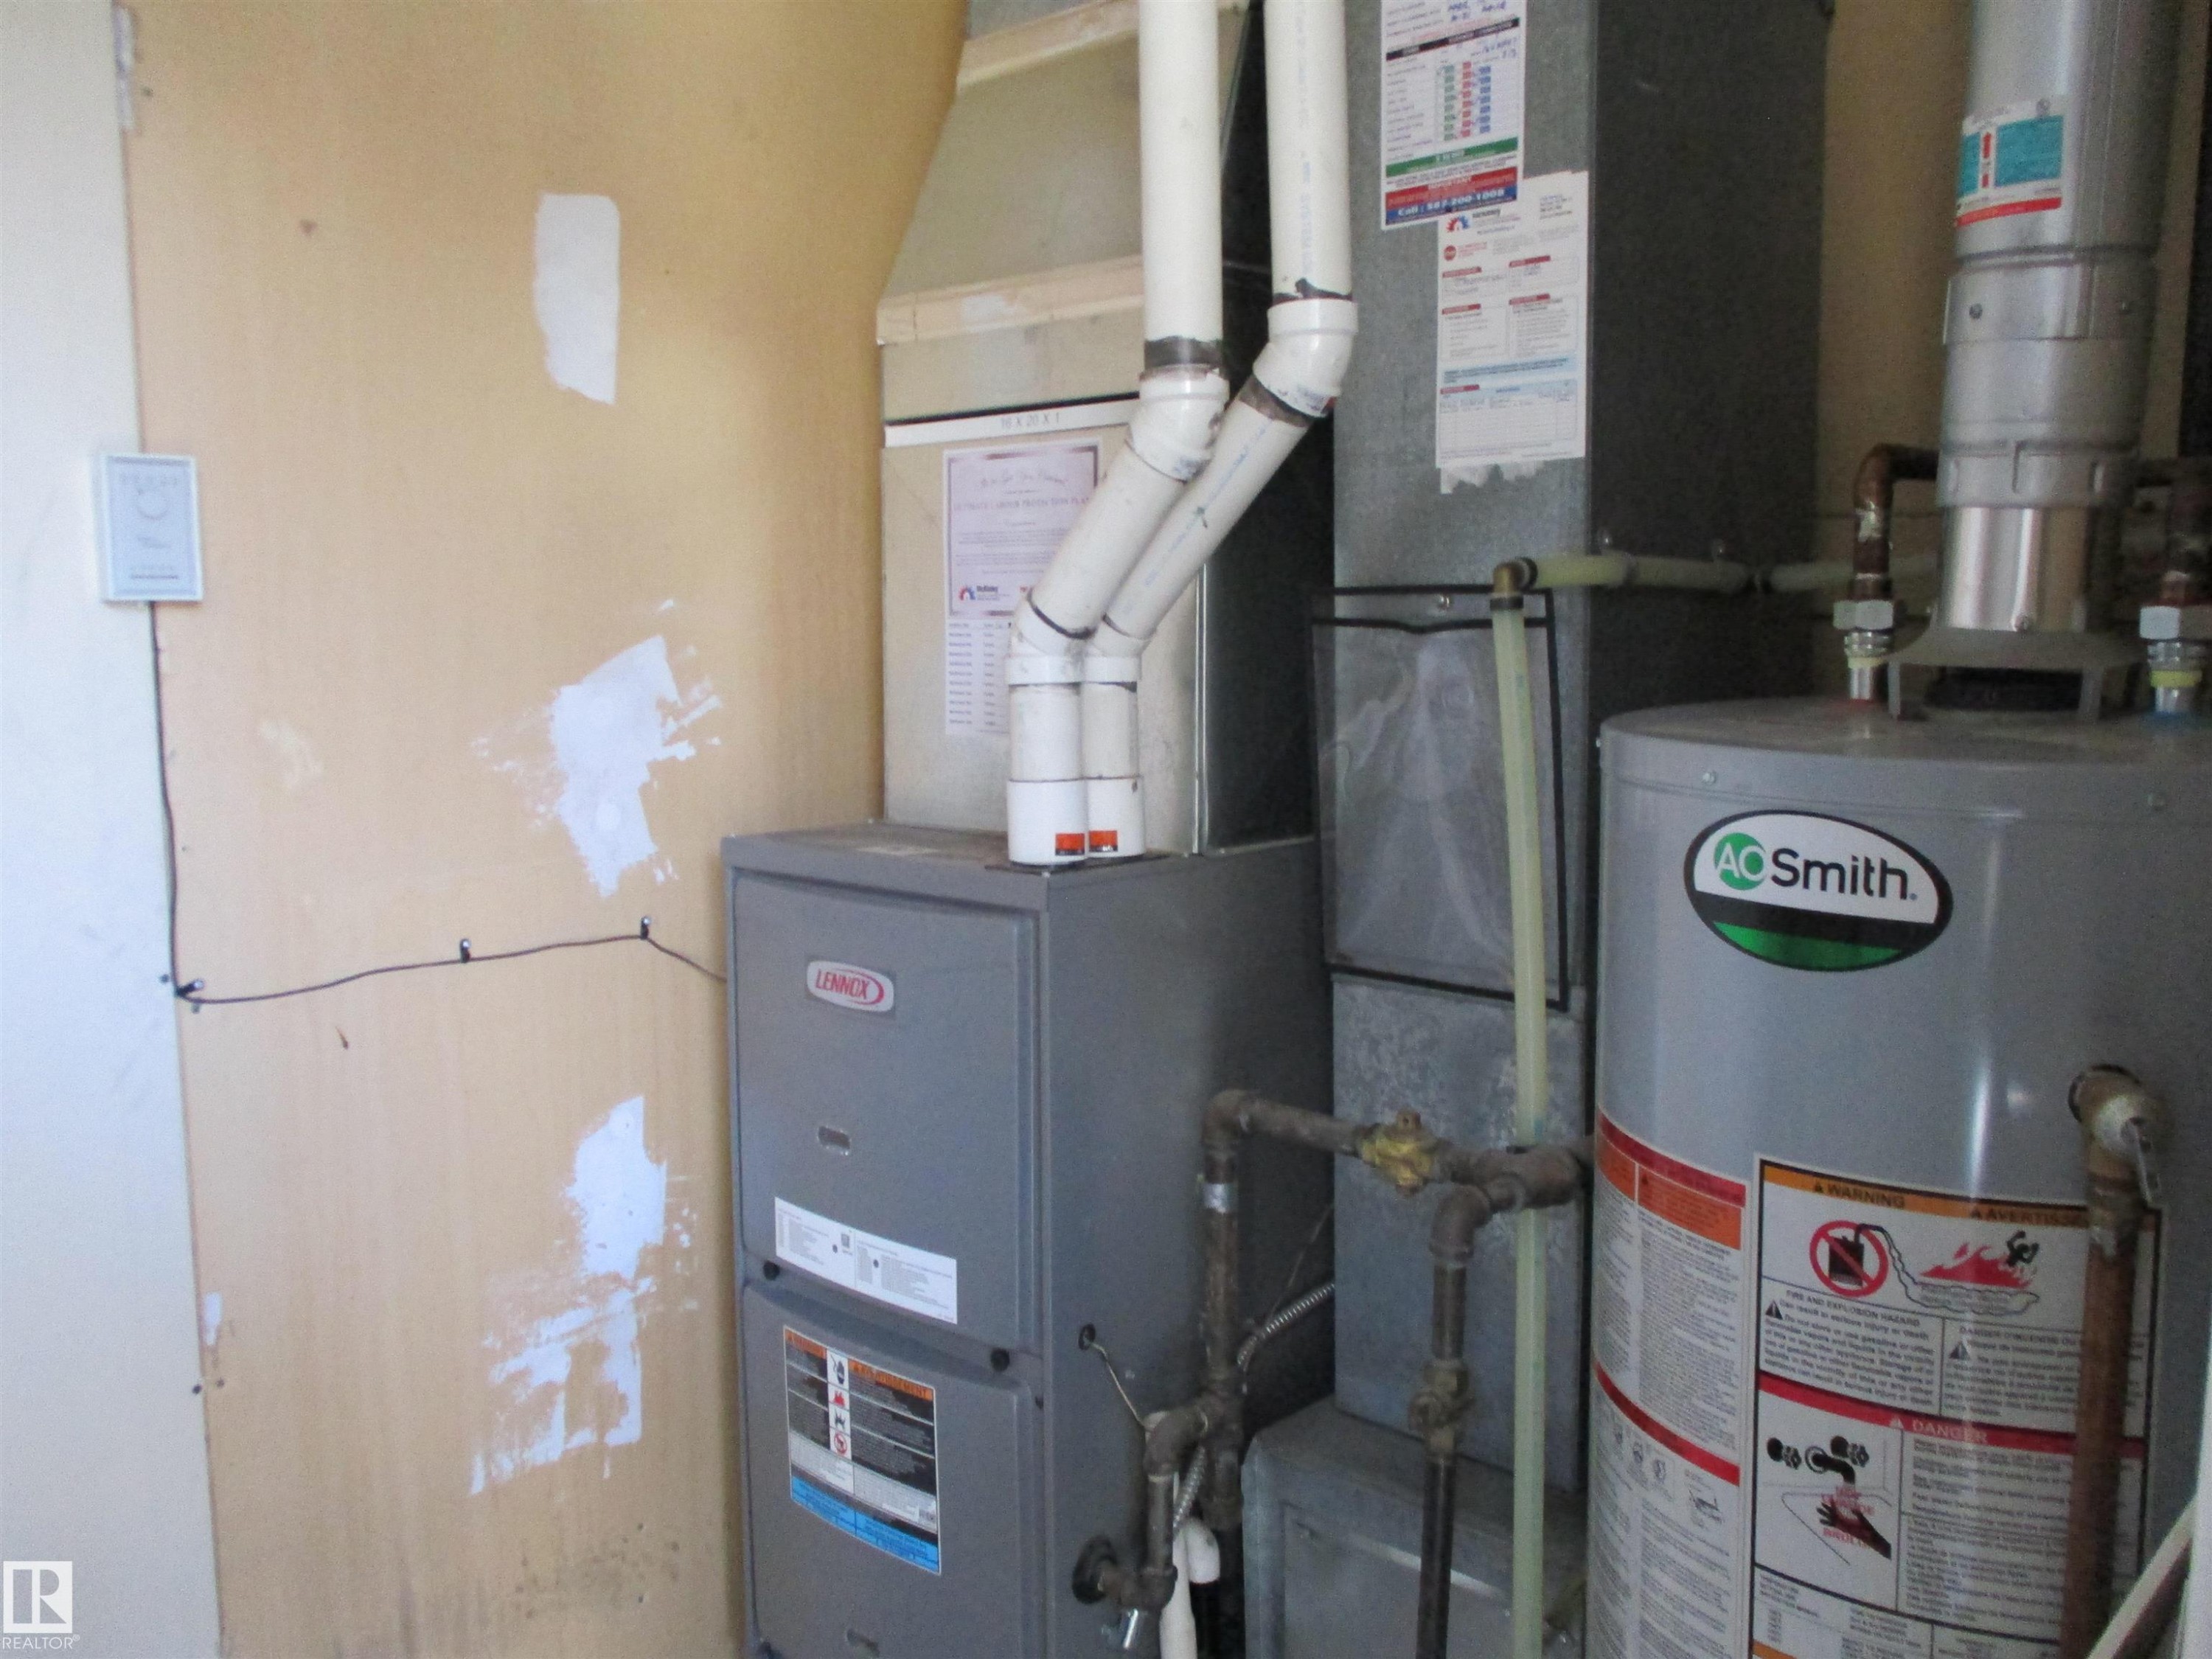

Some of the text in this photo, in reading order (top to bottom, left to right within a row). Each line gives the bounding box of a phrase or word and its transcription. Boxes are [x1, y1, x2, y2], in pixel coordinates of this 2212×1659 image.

[815, 968, 870, 1000] LENNOX
[1829, 1183, 1905, 1208] WARNING
[1913, 1419, 1987, 1444] DANGER
